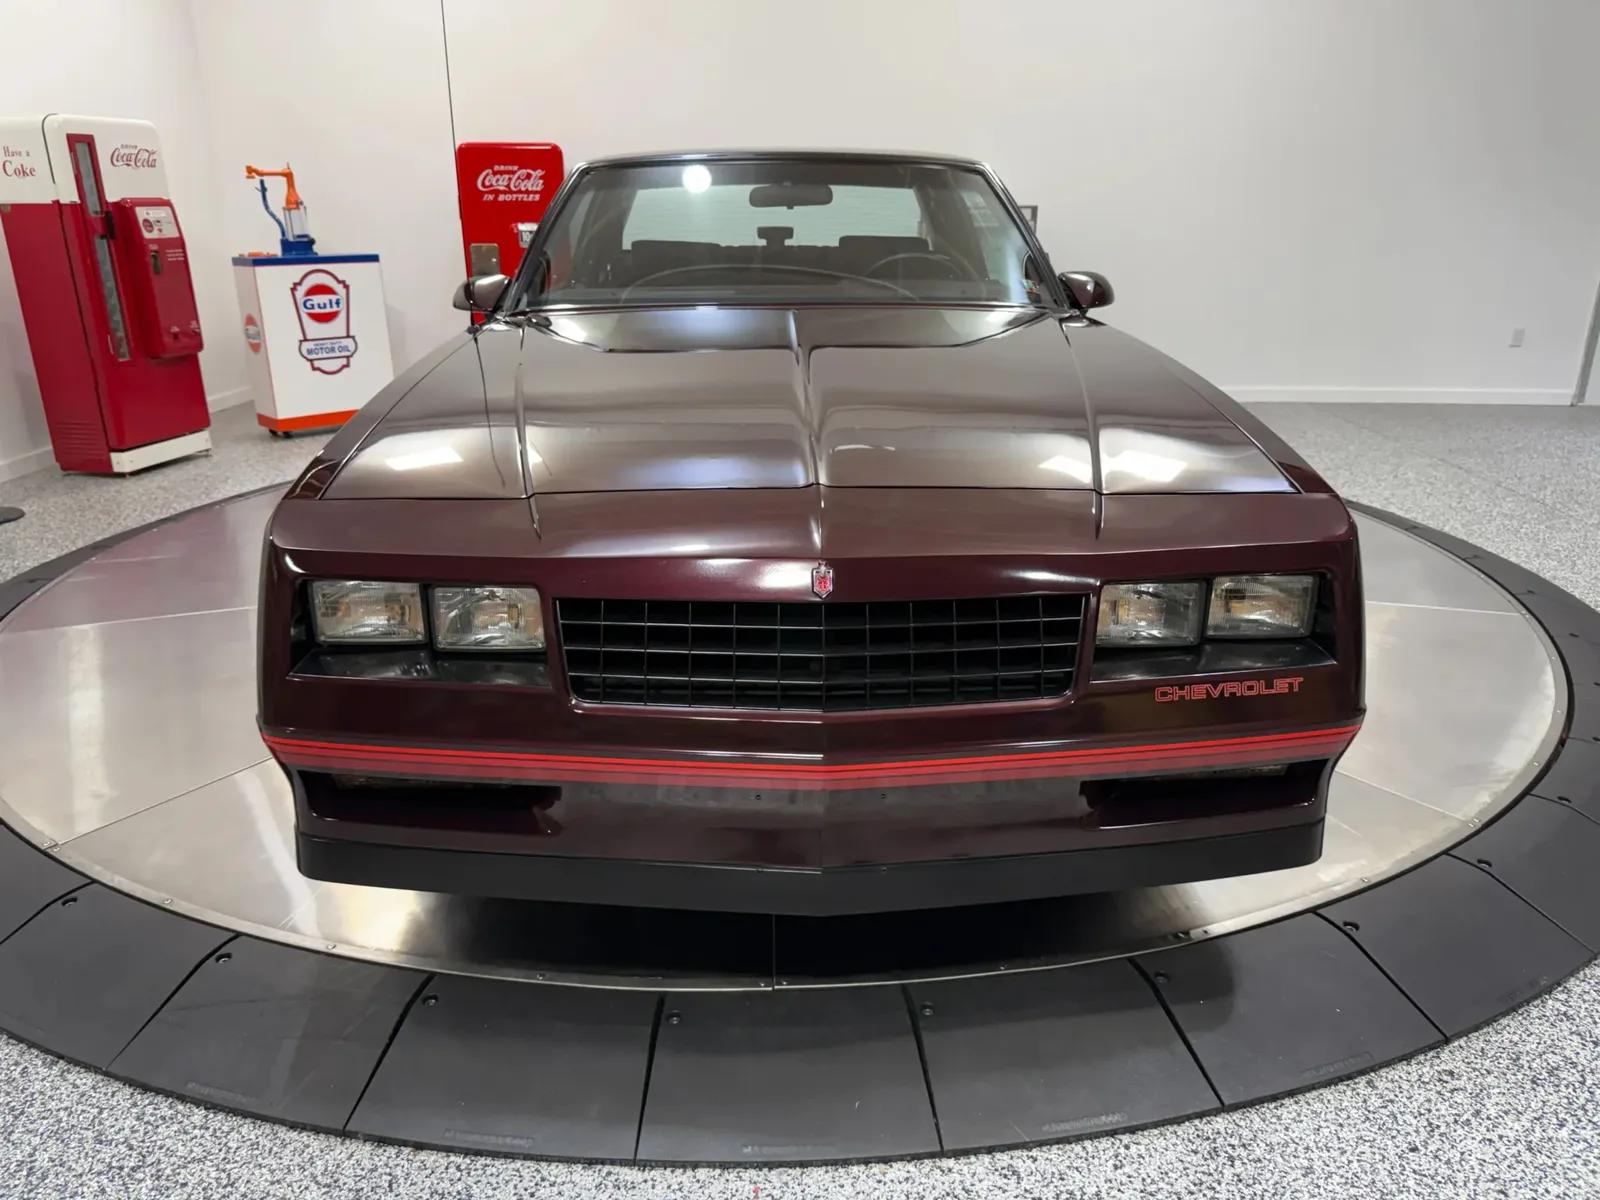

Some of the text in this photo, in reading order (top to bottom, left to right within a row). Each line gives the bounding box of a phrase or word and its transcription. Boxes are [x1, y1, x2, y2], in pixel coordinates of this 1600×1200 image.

[3, 145, 22, 157] Have
[110, 147, 157, 168] Coca-Cola
[2, 160, 36, 177] Coke
[477, 169, 546, 191] Coca-Cola
[302, 298, 341, 310] Gulf
[306, 345, 351, 355] MOTOR OIL
[1154, 677, 1304, 702] CHEVROLET
